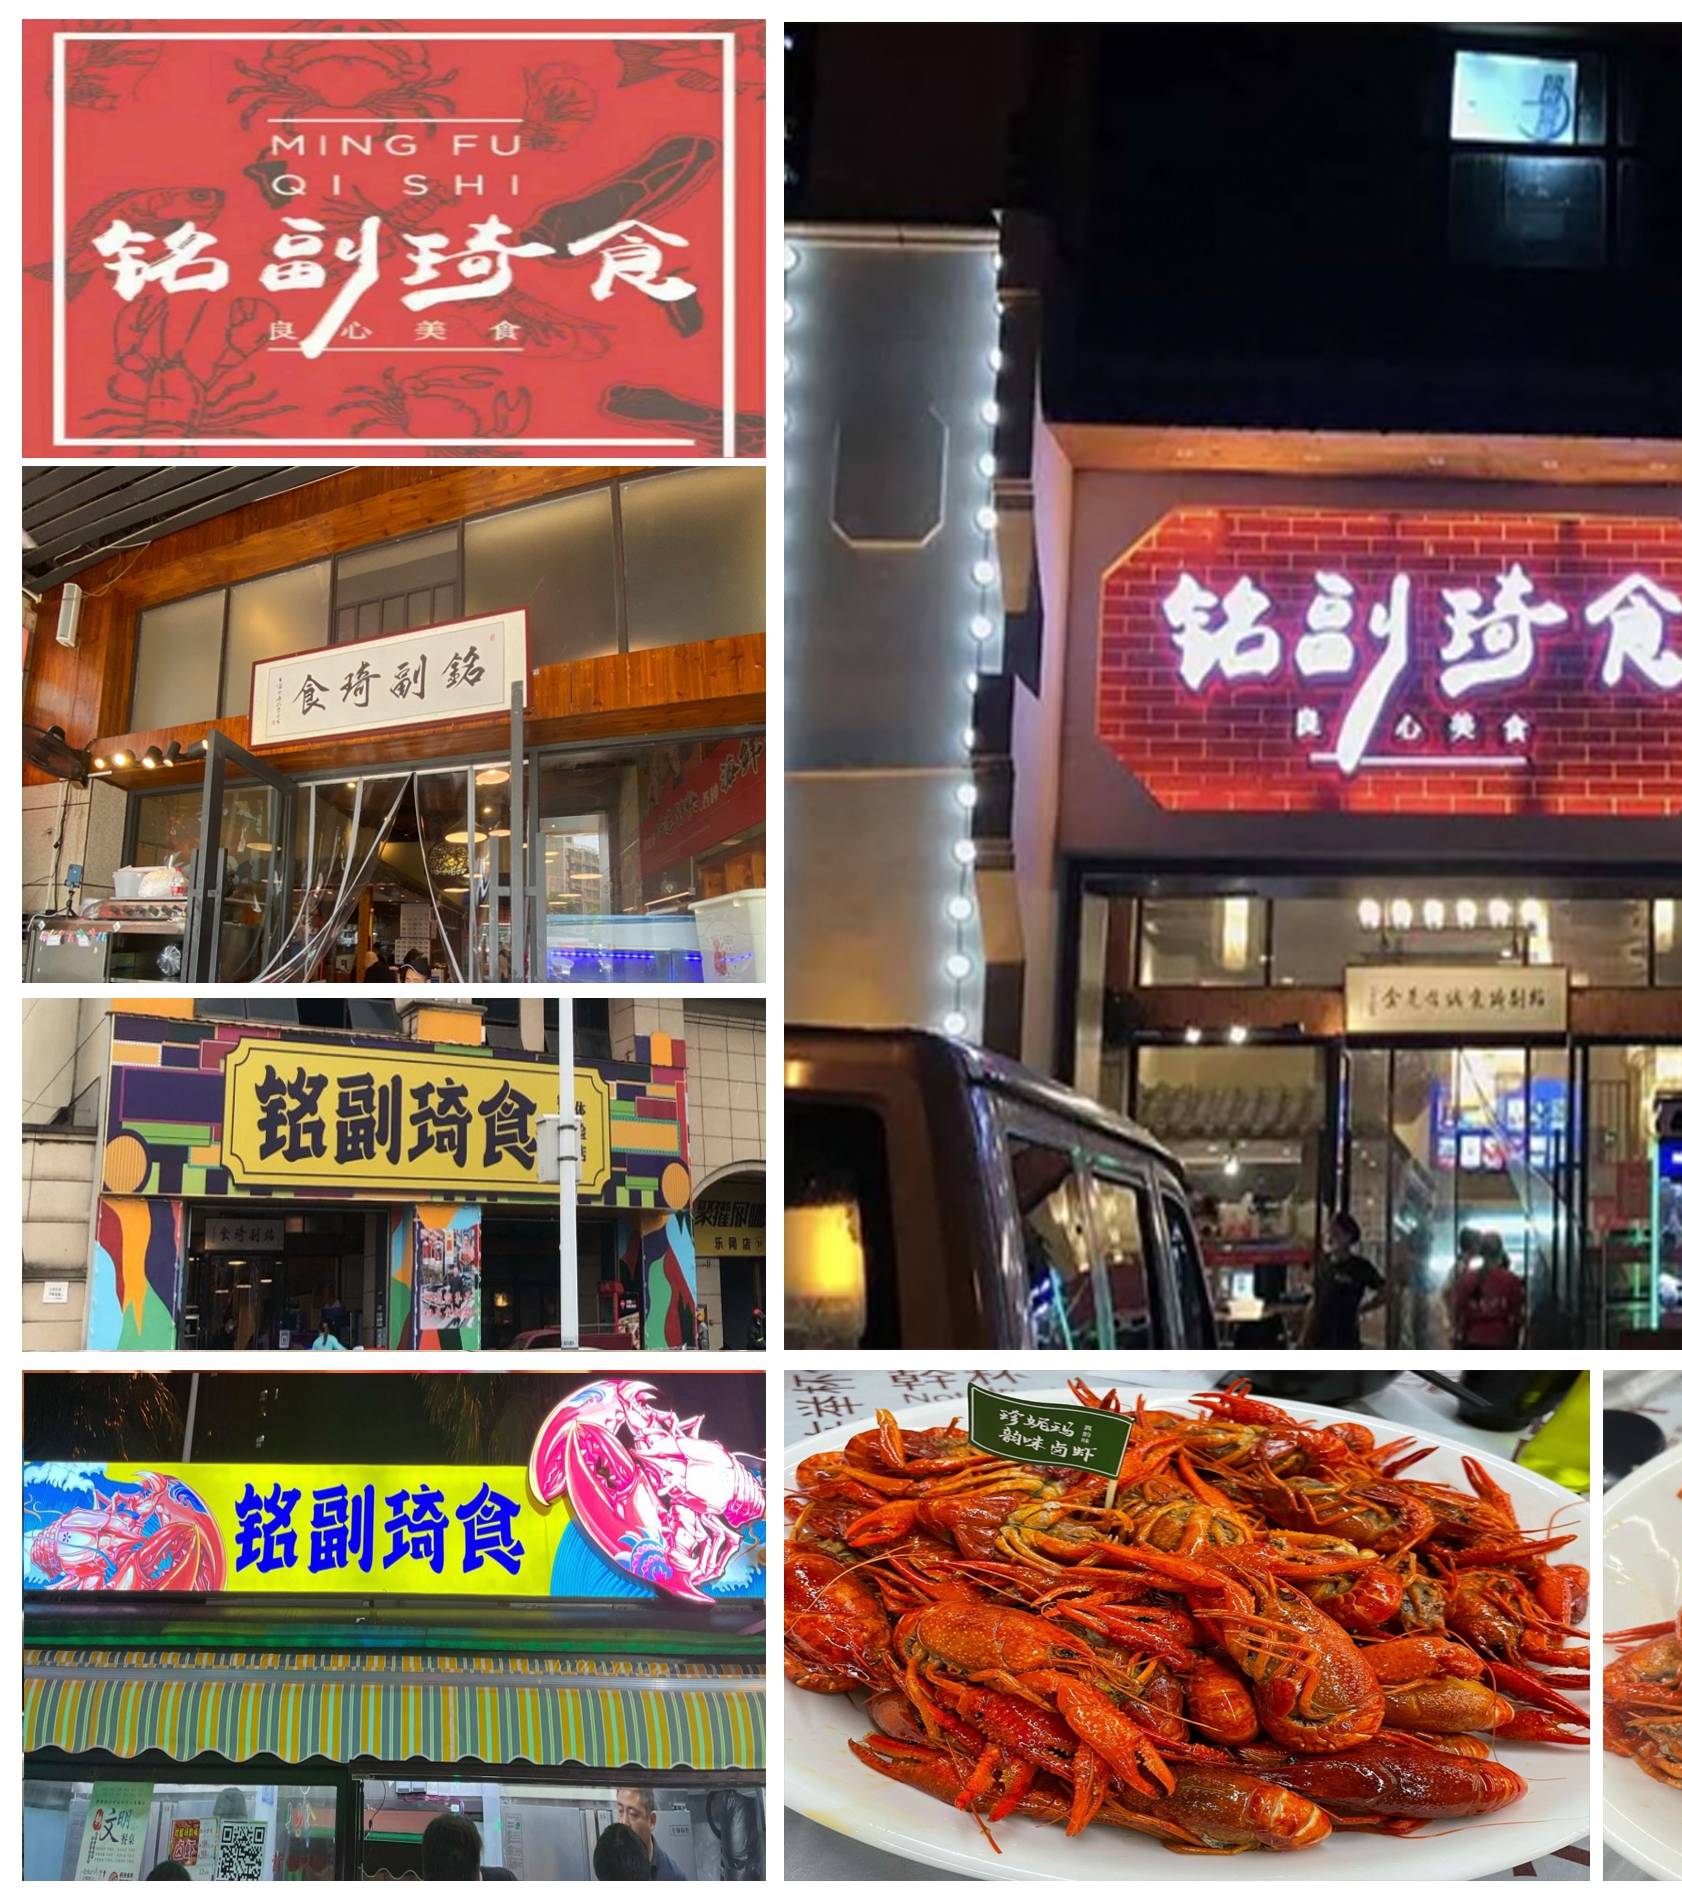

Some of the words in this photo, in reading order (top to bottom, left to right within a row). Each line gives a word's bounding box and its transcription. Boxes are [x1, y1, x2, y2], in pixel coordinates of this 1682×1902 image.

[270, 133, 418, 157] MING
[452, 133, 522, 157] FU
[270, 173, 341, 197] QI
[402, 173, 520, 197] SHI
[92, 214, 697, 359] 铭副琦食
[268, 319, 521, 342] 良心美食
[254, 1063, 540, 1168] 铭副琦食
[233, 1481, 526, 1575] 铭副琦食
